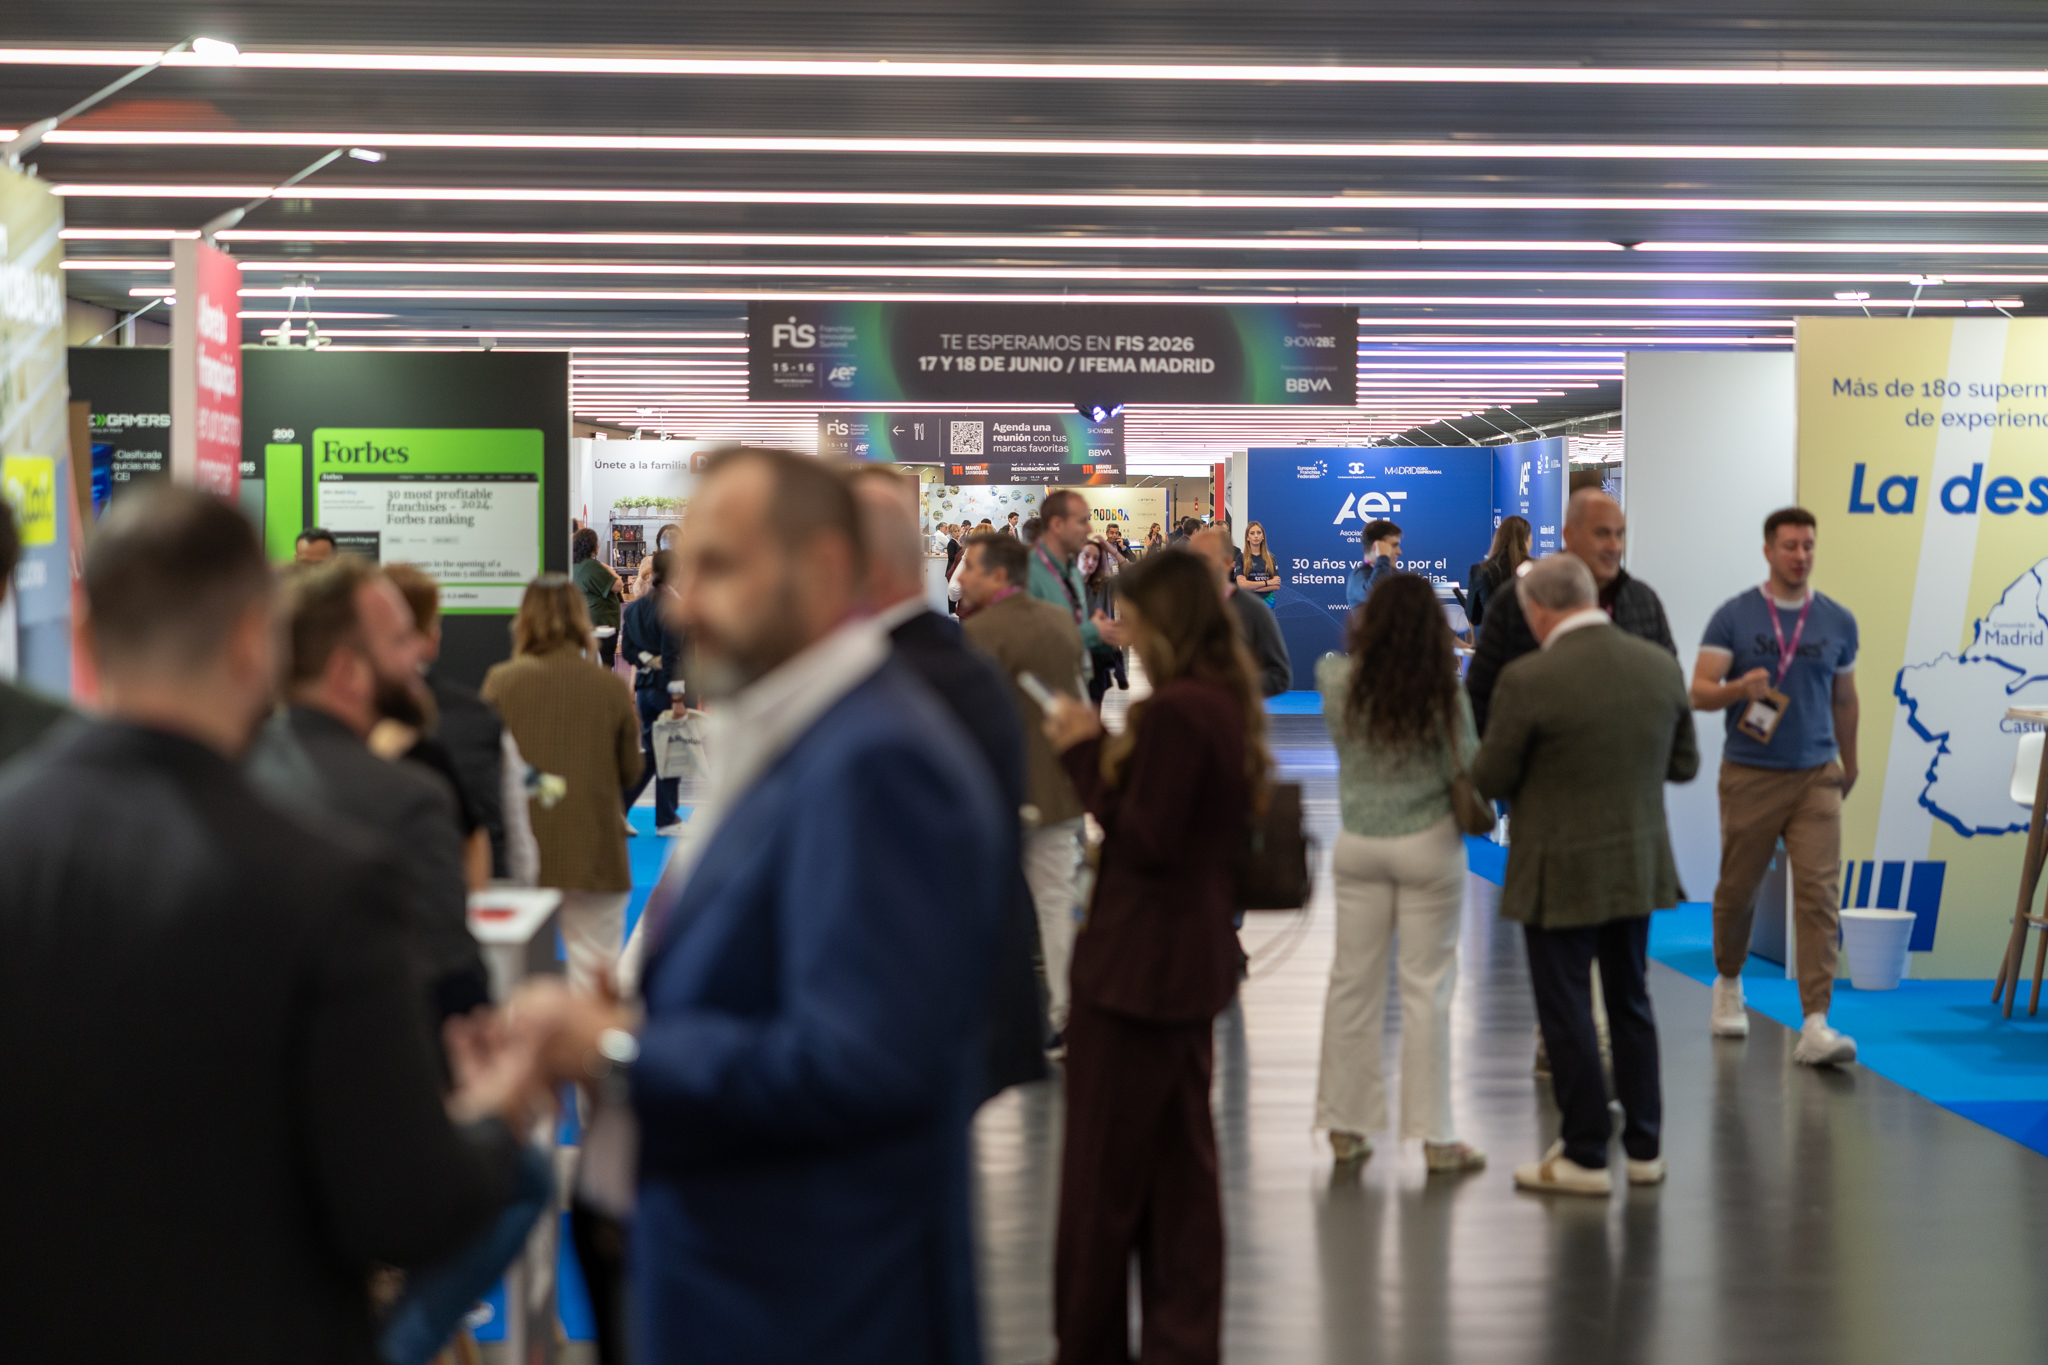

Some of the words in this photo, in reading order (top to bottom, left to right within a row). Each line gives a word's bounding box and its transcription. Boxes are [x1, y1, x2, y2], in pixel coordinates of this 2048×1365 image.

[940, 334, 963, 350] TE
[967, 335, 1082, 351] ESPERAMOS
[1086, 335, 1111, 351] EN
[1115, 336, 1144, 352] FIS
[1148, 336, 1195, 352] 2026
[918, 356, 938, 372] 17
[940, 356, 953, 372] Y
[956, 356, 976, 372] 18
[980, 356, 1005, 372] DE
[1008, 356, 1063, 373] JUNIO
[1079, 357, 1137, 373] IFEMA
[1140, 357, 1215, 374] MADRID
[1286, 378, 1332, 393] BBVA
[1832, 377, 1878, 397] Más
[1885, 378, 1914, 397] de
[1921, 379, 1961, 397] 180
[1905, 408, 1935, 427] de
[272, 428, 295, 439] 200
[993, 423, 1030, 433] Agenda
[1032, 424, 1051, 432] una
[993, 433, 1031, 442] reunión
[1052, 434, 1067, 442] tus
[322, 440, 409, 464] Forbes
[1029, 443, 1069, 453] favoritas
[116, 450, 162, 460] Clasificada
[113, 462, 142, 471] quicias
[143, 461, 161, 470] más
[594, 459, 627, 469] Únete
[639, 461, 648, 469] la
[651, 460, 687, 469] familia
[387, 490, 400, 500] 30
[403, 490, 433, 500] most
[436, 487, 493, 501] profitable
[1848, 462, 1919, 515] La
[1940, 462, 2048, 515] des
[387, 500, 447, 512] franchises
[386, 514, 425, 526] Forbes
[429, 514, 475, 527] ranking
[456, 561, 487, 569] opening
[1292, 558, 1309, 570] 30
[1313, 558, 1346, 570] años
[1408, 560, 1431, 571] por
[1434, 558, 1447, 570] el
[1292, 573, 1345, 584] sistema
[1985, 629, 2043, 645] Madrid
